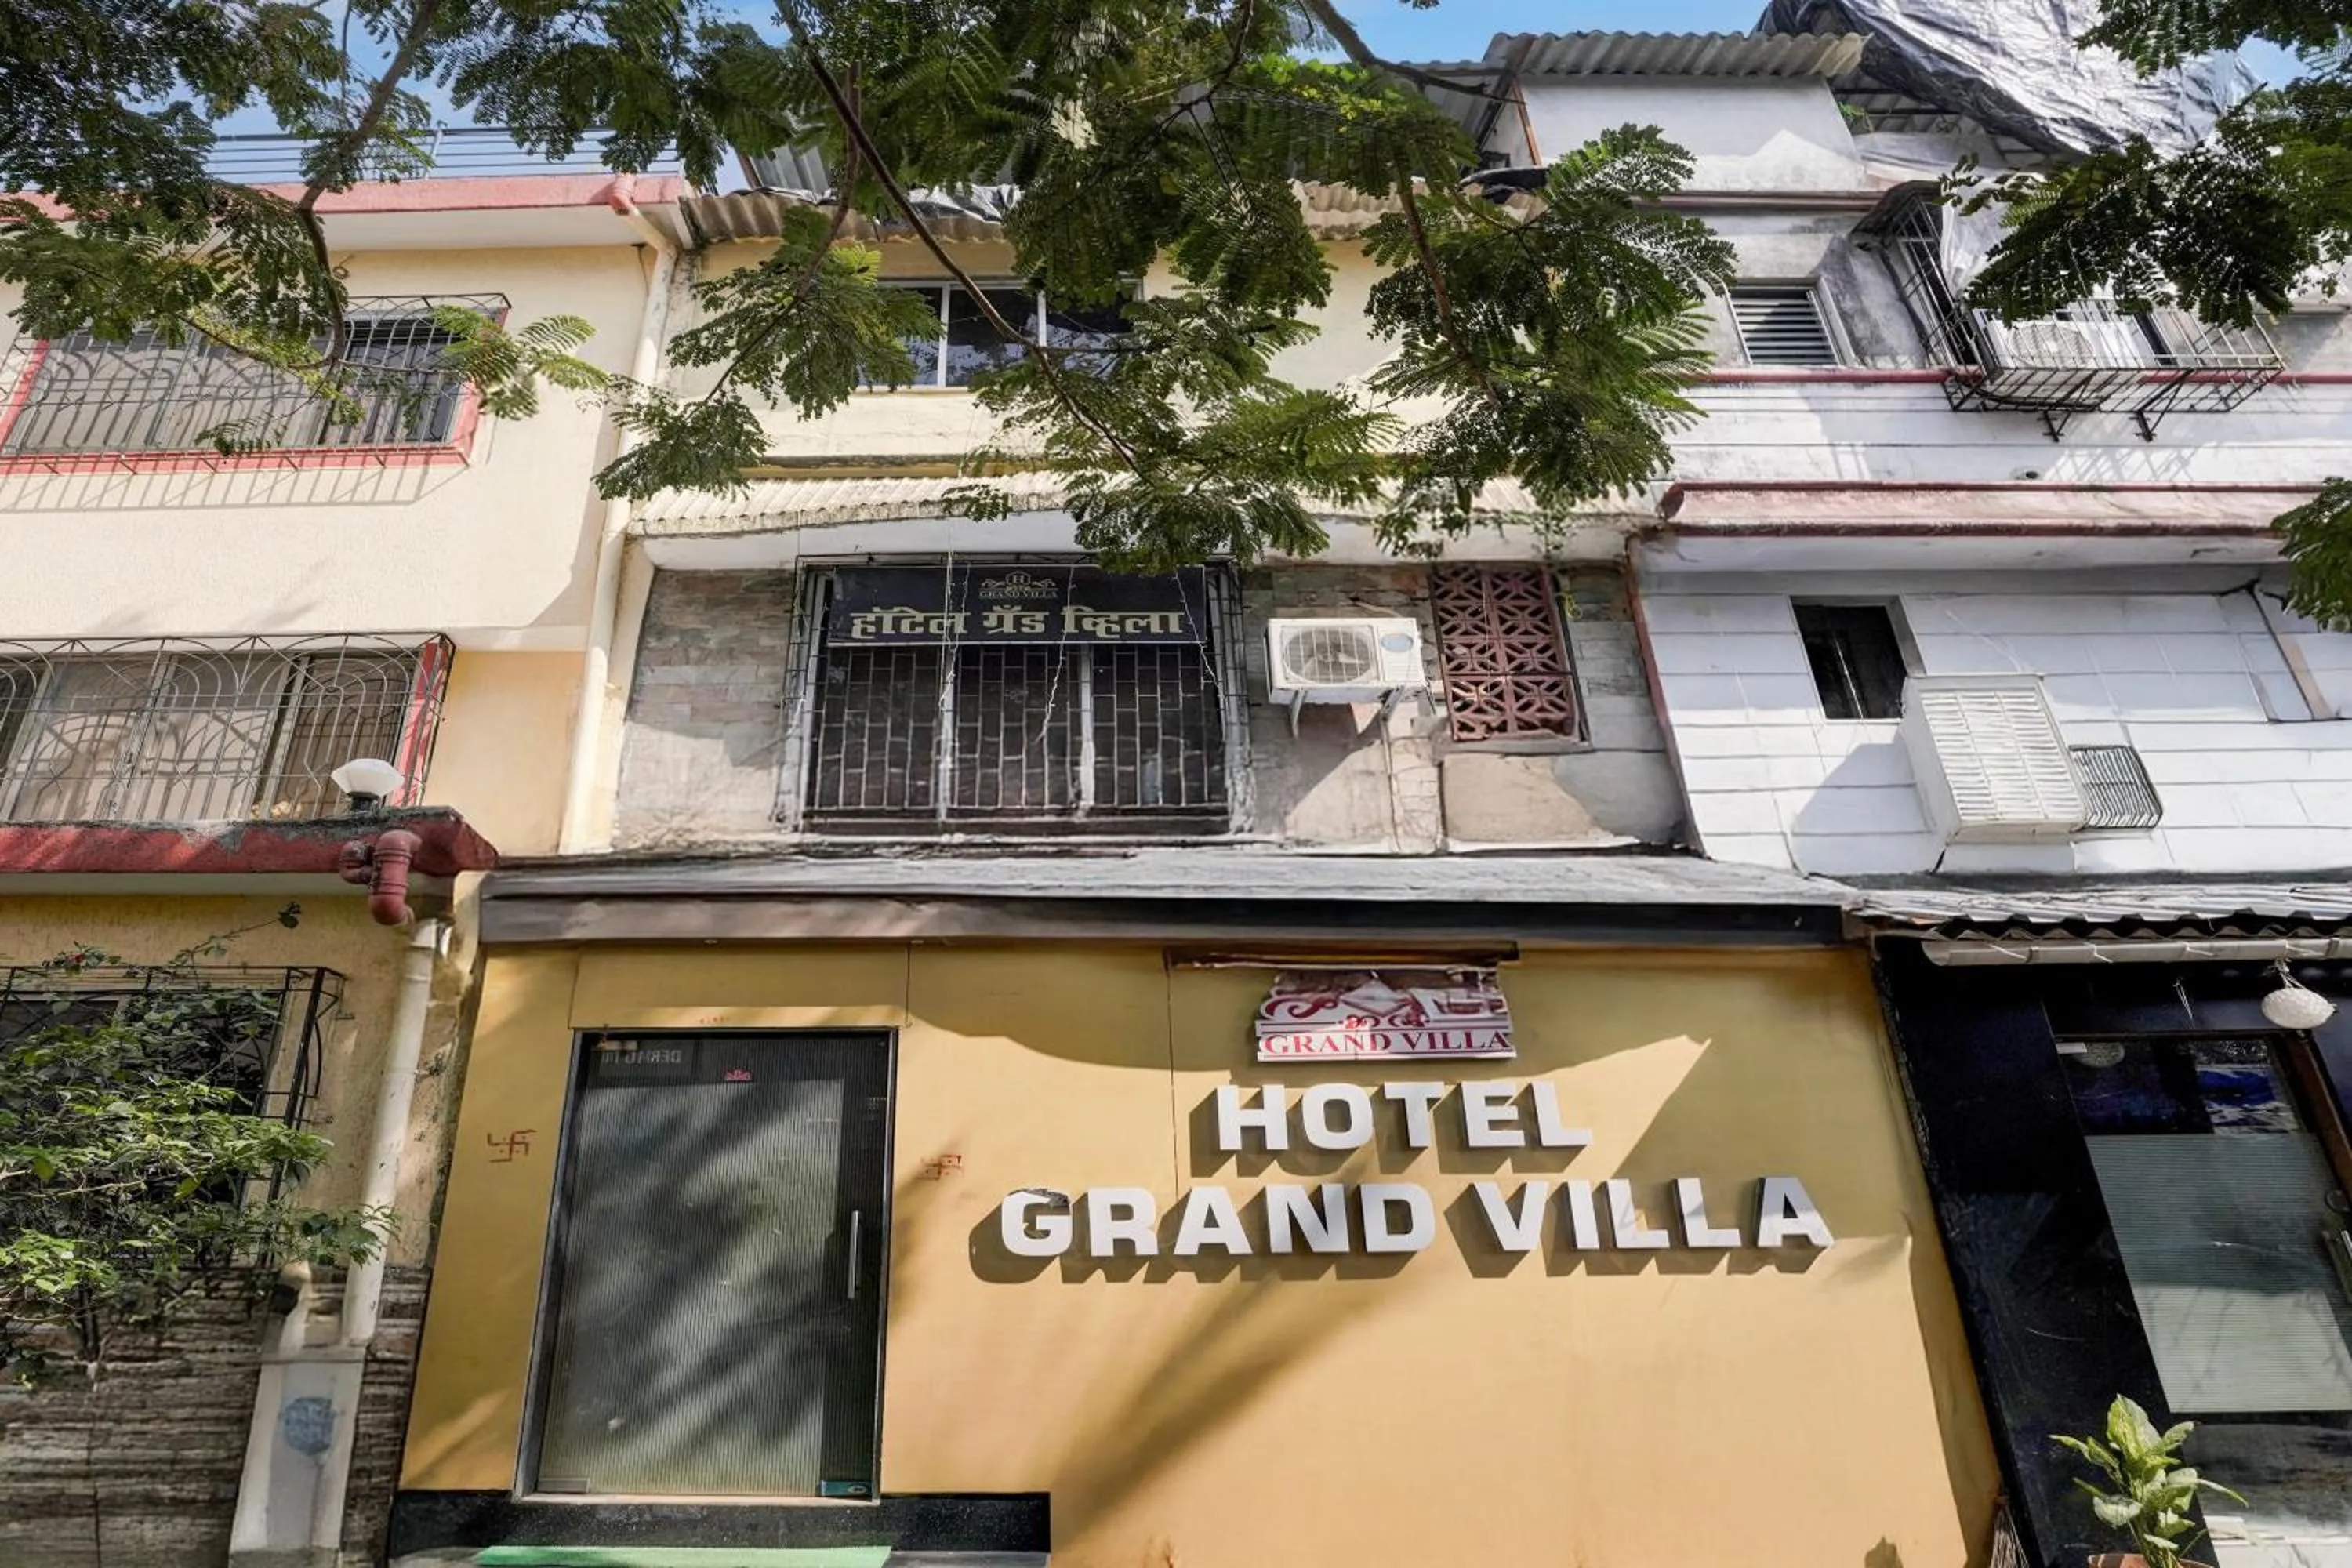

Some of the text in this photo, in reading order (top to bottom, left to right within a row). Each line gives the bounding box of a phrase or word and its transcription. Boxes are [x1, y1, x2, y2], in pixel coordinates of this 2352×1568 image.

[850, 606, 971, 639] हॉटेल
[1061, 604, 1185, 639] व्हिला
[1262, 1030, 1511, 1054] GRAND VILLA
[1217, 1081, 1592, 1150] HOTEL
[1001, 1177, 1835, 1258] GRAND VILLA
